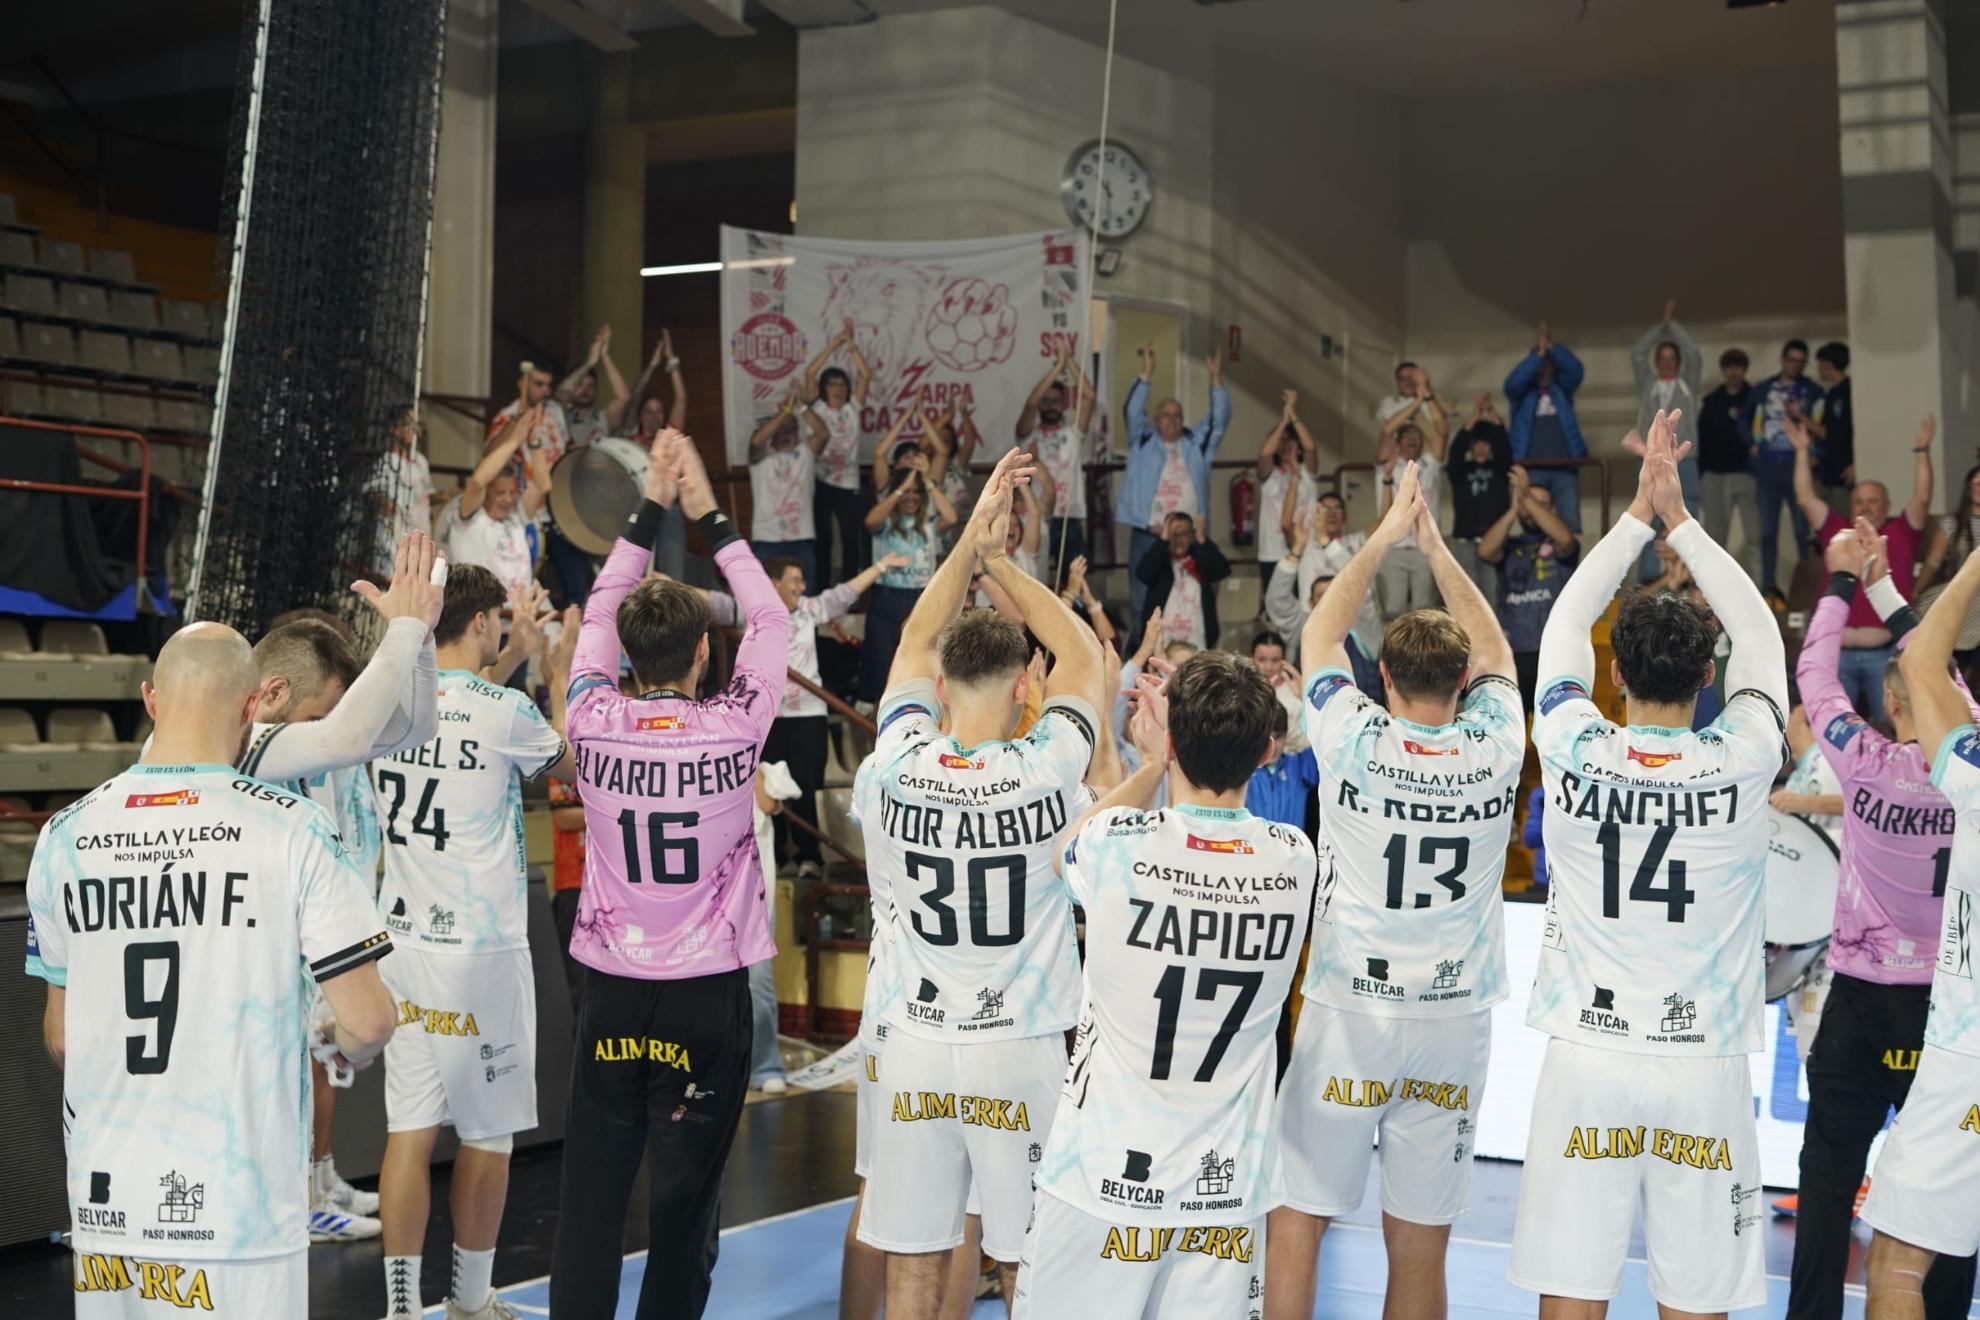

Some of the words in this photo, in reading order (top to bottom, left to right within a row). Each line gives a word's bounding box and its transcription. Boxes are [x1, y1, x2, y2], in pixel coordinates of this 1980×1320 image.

[466, 680, 503, 700] alsa
[438, 710, 471, 723] LEÓN
[459, 740, 486, 770] S.
[646, 748, 690, 756] IMPULSA
[175, 765, 195, 774] LEÓN
[678, 743, 757, 798] PÉREZ
[1366, 760, 1440, 786] CASTILLA
[1445, 774, 1455, 787] Y
[1457, 767, 1493, 785] LEÓN
[231, 779, 299, 809] alsa
[898, 774, 965, 797] CASTILLA
[971, 787, 980, 799] Y
[982, 778, 1022, 797] LEÓN
[1395, 783, 1411, 792] NOS
[1413, 786, 1463, 797] IMPULSA
[1631, 777, 1684, 788] IMPULSA
[925, 794, 941, 802] NOS
[943, 796, 990, 807] IMPULSA
[1338, 778, 1369, 814] R.
[379, 769, 450, 851] 24
[955, 789, 1067, 849] ALBIZU
[1195, 808, 1212, 817] ESTO
[1213, 810, 1222, 818] ES
[1223, 809, 1236, 819] LEÓN
[76, 829, 168, 850] CASTILLA
[172, 829, 185, 845] Y
[188, 821, 241, 843] LEÓN
[617, 809, 700, 884] 16
[114, 853, 135, 862] NOS
[137, 848, 194, 864] IMPULSA
[1133, 861, 1231, 889] CASTILLA
[1234, 877, 1247, 892] Y
[1251, 873, 1298, 891] LEÓN
[1383, 833, 1470, 910] 13
[1596, 821, 1695, 923] 14
[63, 862, 207, 934] ADRIÁN
[221, 871, 256, 929] F.
[904, 850, 1028, 947] 30
[1173, 887, 1194, 898] NOS
[1197, 891, 1260, 905] IMPULSA
[1126, 898, 1295, 961] ZAPICO
[1944, 947, 1952, 966] DE
[1353, 977, 1405, 997] BELYCAR
[1419, 993, 1438, 1002] PASO
[1440, 989, 1472, 1001] HONROSO
[124, 941, 180, 1075] 9
[1579, 1009, 1629, 1031] BELYCAR
[980, 1018, 1014, 1030] HONROSO
[1149, 964, 1264, 1083] 17
[1646, 1034, 1668, 1043] PASO
[1670, 1034, 1705, 1043] HONROSO
[595, 1036, 692, 1073] ALIMRKA
[892, 1091, 1031, 1132] ALIMERKA
[1565, 1125, 1732, 1171] ALIMERKA
[1099, 1195, 1113, 1203] OBRA
[1114, 1199, 1126, 1207] CIVIL
[1101, 1178, 1164, 1204] BELYCAR
[1180, 1201, 1203, 1211] PASO
[1205, 1197, 1243, 1210] HONROSO
[78, 1207, 126, 1229] BELYCAR
[143, 1229, 164, 1240] PASO
[167, 1230, 214, 1241] HONROSO
